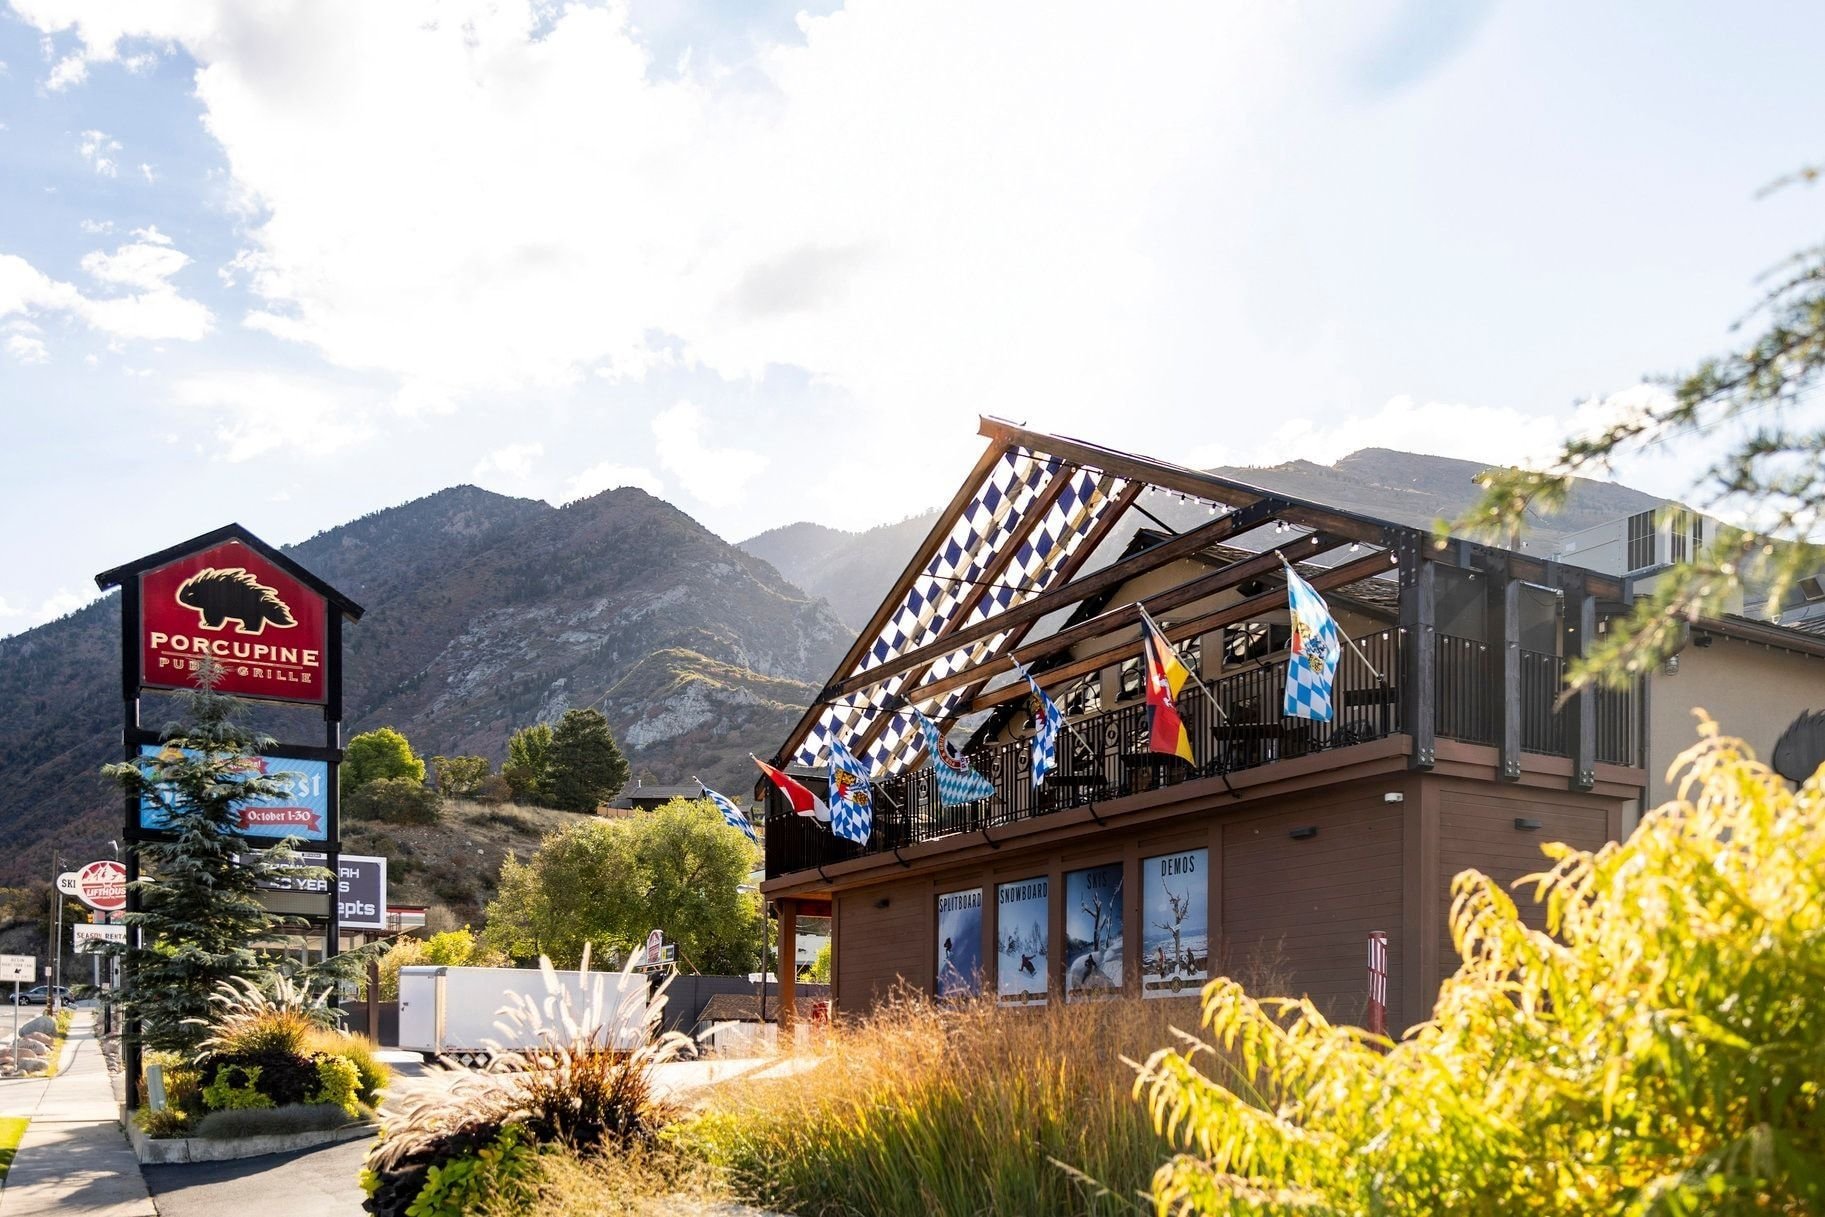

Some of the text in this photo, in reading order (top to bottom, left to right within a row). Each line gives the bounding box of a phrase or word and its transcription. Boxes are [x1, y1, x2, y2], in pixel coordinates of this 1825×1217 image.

[150, 631, 320, 667] PORCUPINE
[159, 657, 200, 671] PUB
[237, 666, 312, 684] GRILLE
[247, 811, 312, 822] October 1-30
[1161, 855, 1195, 877] DEMOS
[61, 878, 76, 889] SKI
[1087, 870, 1108, 890] SKIS
[86, 886, 126, 898] LIFTHOUS
[1000, 882, 1048, 904] SNOWBOARD
[939, 892, 982, 913] SPLITBOARD
[104, 932, 127, 941] RENTA
